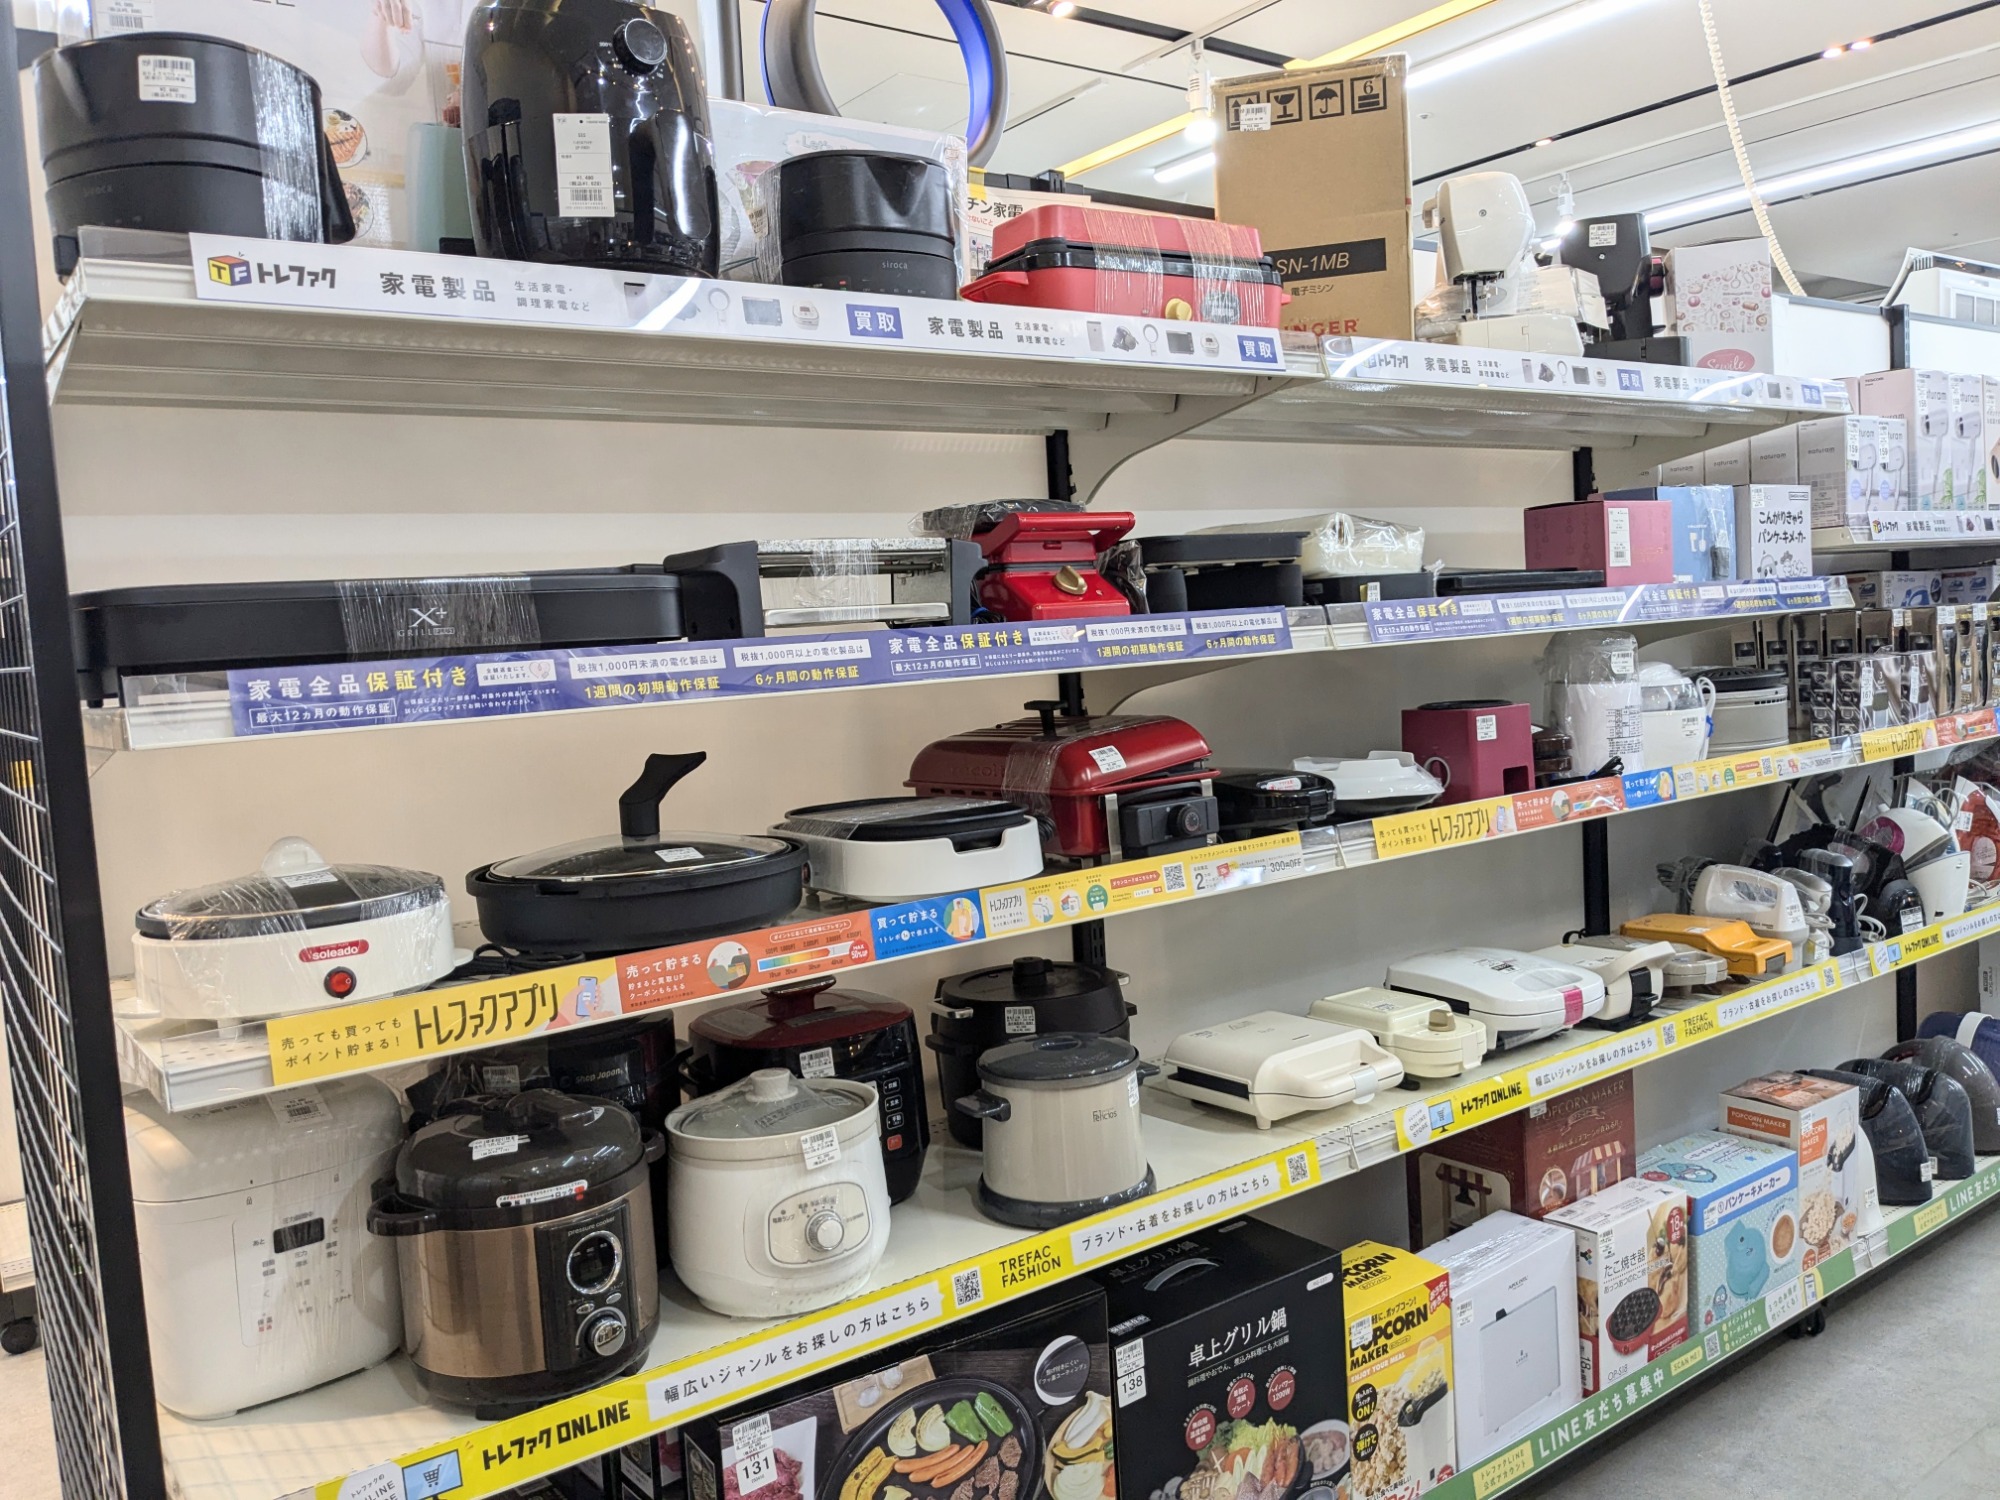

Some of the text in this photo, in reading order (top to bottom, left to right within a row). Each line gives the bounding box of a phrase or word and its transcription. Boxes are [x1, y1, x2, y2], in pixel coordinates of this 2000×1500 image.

[1363, 80, 1374, 95] 6
[881, 260, 909, 270] siroca
[1276, 252, 1350, 276] SN-1MB
[257, 261, 337, 289] トレファク
[379, 270, 497, 303] 家電製品
[1290, 283, 1335, 297] 電子ミシン
[516, 296, 592, 312] 調理家電など
[852, 310, 898, 333] 買取
[927, 315, 1004, 340] 家電製品
[1016, 334, 1067, 348] 調理家電など
[1241, 341, 1277, 359] 買取
[1378, 353, 1472, 375] トレファク 家電製品
[1619, 372, 1641, 389] 買取
[1759, 450, 1787, 461] naturam
[1758, 510, 1804, 526] こんがりきゃら
[1757, 528, 1807, 545] パンケーキメーカー
[397, 628, 433, 637] GRILL
[1090, 619, 1182, 636] 税抜1,000円未満の電化製品は
[1195, 616, 1278, 631] 税抜1,000円以上の電化製品は
[888, 630, 1025, 655] 家電全品保証付き
[1096, 640, 1185, 660] 1週間の初期動作保証
[740, 644, 864, 662] 税抜1,000円以上の電化製品は
[576, 655, 719, 674] 税抜1,000円未満の電化製品は
[247, 665, 468, 702] 家電全品保証付き
[482, 672, 532, 681] 保証いたします。
[584, 676, 721, 700] 1週間の初期動作保証
[1378, 822, 1427, 840] 売っても買っても
[1429, 808, 1491, 845] トレファクアプリ
[1111, 872, 1157, 888] ダウンロードはこちらから
[1194, 872, 1206, 891] 2
[876, 908, 938, 931] 買って貯まる
[311, 946, 359, 962] soleado
[625, 953, 702, 980] 売って貯まる
[628, 973, 685, 991] 貯まると買取UP
[629, 983, 687, 1001] クーポンもらえる
[1721, 980, 1817, 1021] ブランド・古着をお探しの方はこちら
[413, 982, 559, 1050] トレファクアプリ
[1683, 1012, 1709, 1028] TREFAC
[280, 1017, 403, 1051] 売っても買っても
[1684, 1020, 1714, 1038] FASHION
[1534, 1036, 1655, 1088] 幅広いジャンルをお探しの方はこちら
[575, 1073, 597, 1083] Shop
[1460, 1081, 1523, 1116] トレファク ONLINE
[1591, 1080, 1625, 1101] MAKER
[1731, 1111, 1787, 1129] POPCORN MAKER
[1801, 1135, 1820, 1148] MAKER
[554, 1188, 575, 1199] ロック
[1081, 1174, 1271, 1252] ブランド・古着をお探しの方はこちら
[566, 1215, 617, 1237] pressure cooker
[1670, 1215, 1680, 1232] 18
[252, 1239, 265, 1247] あと
[999, 1244, 1052, 1273] TREFAC
[1603, 1248, 1646, 1280] たこ焼き器
[1001, 1256, 1062, 1289] FASHION
[1344, 1267, 1387, 1289] MAKER
[1187, 1306, 1288, 1368] 卓上グリル鍋
[663, 1296, 931, 1404] 幅広いジャンルをお探しの方はこちら
[1349, 1343, 1390, 1372] MAKER
[1350, 1350, 1407, 1384] ENJOY YOUR MEAL
[1121, 1375, 1144, 1394] 138
[1269, 1379, 1295, 1395] ハイパワー
[1271, 1388, 1291, 1402] 1200W
[1231, 1400, 1252, 1415] プレート
[1356, 1402, 1376, 1421] ON!
[1538, 1366, 1665, 1459] LINE友だち募集中
[481, 1399, 632, 1471] トレファク ONLINE
[742, 1456, 770, 1479] 131
[1480, 1447, 1526, 1481] トレファクLINE
[1483, 1460, 1527, 1491] 公式アカウント
